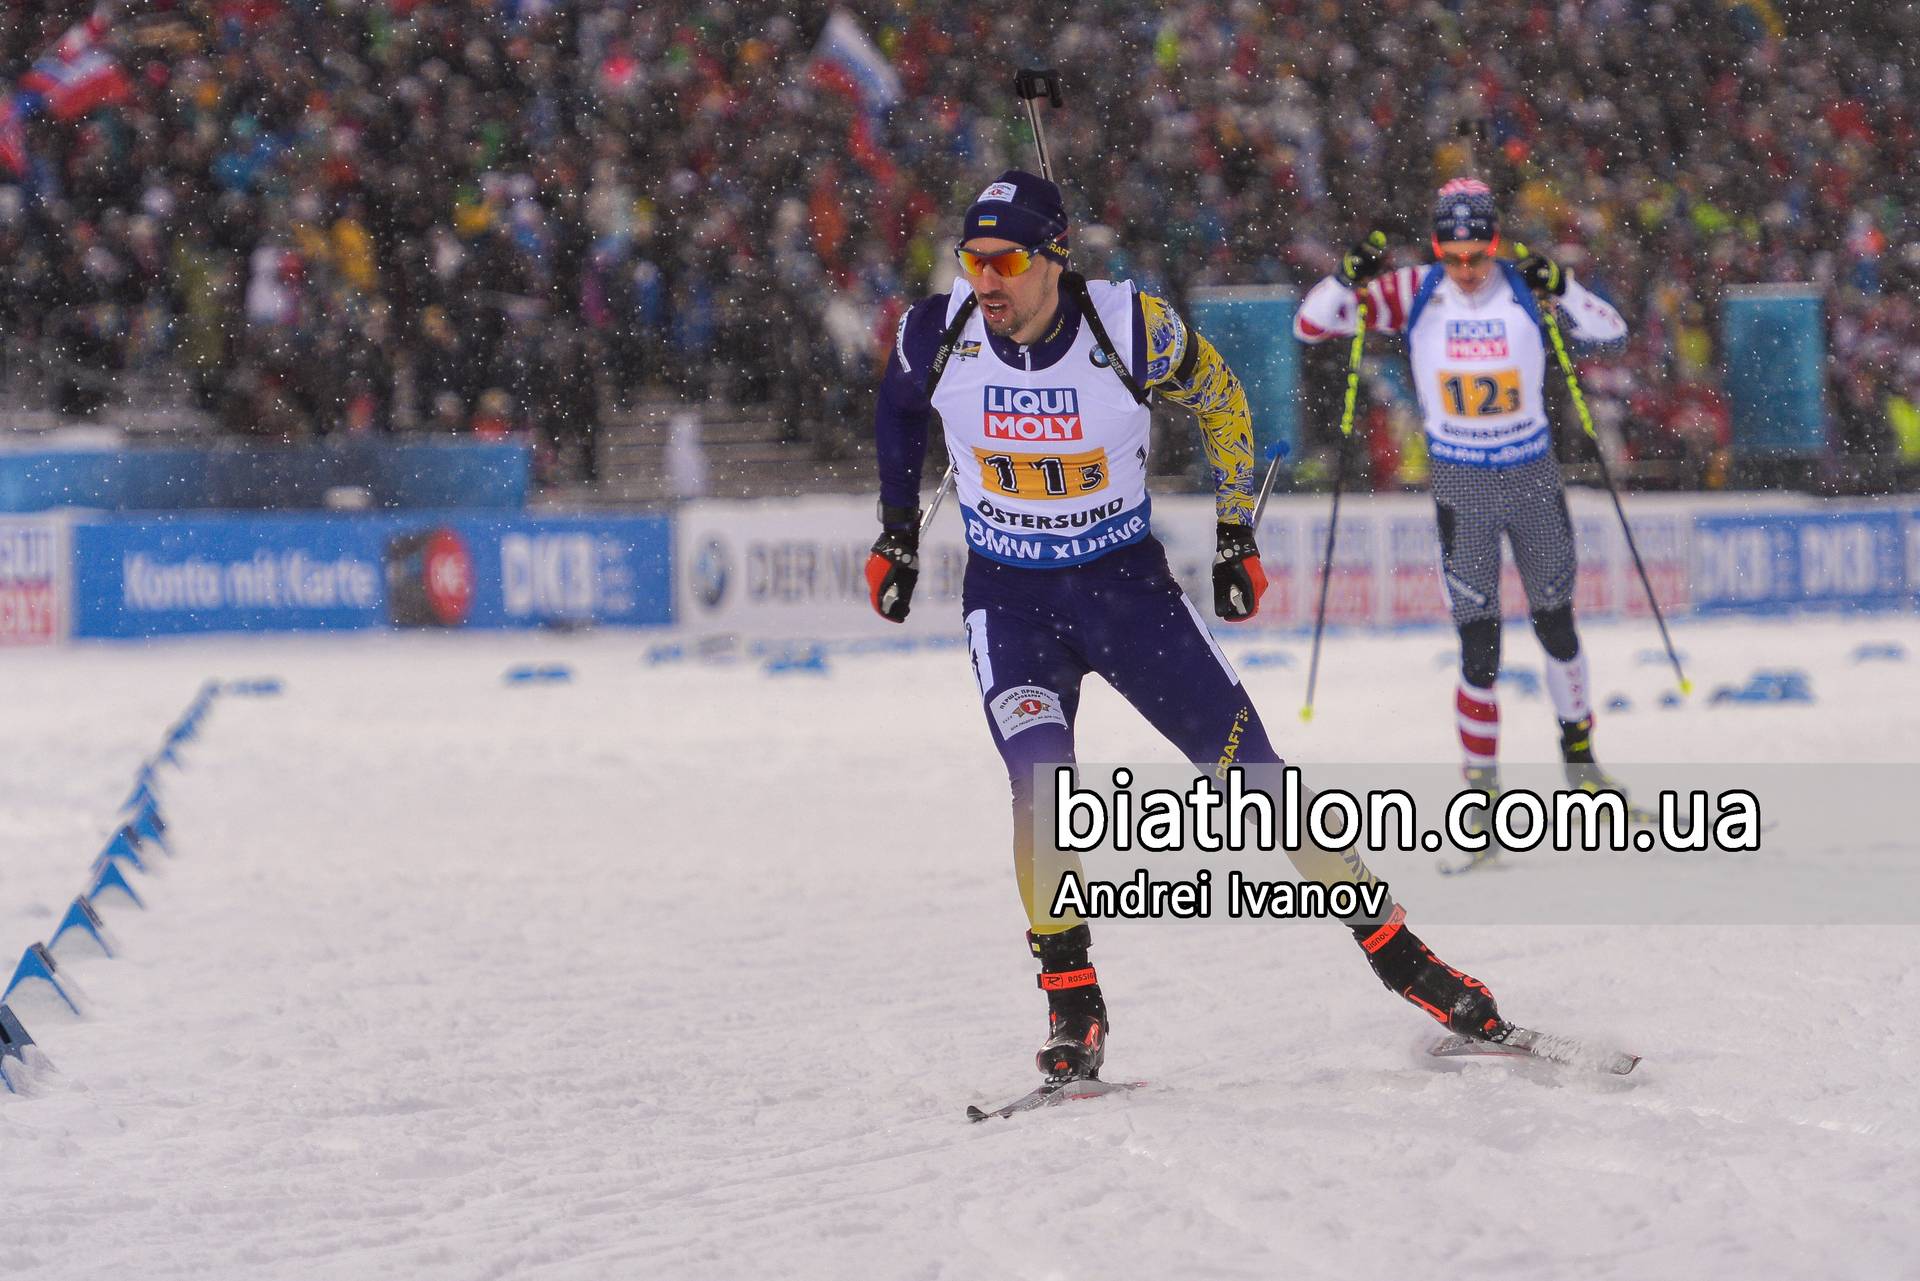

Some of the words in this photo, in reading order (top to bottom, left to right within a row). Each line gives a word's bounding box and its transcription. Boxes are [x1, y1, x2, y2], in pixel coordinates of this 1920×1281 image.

[1048, 243, 1070, 258] RAFT
[988, 387, 1074, 415] LIQUI
[1445, 376, 1503, 416] 12
[988, 415, 1079, 440] MOLY
[976, 496, 1124, 530] ÖSTERSUND
[968, 517, 1042, 560] BMW
[1051, 514, 1146, 560] xDrive
